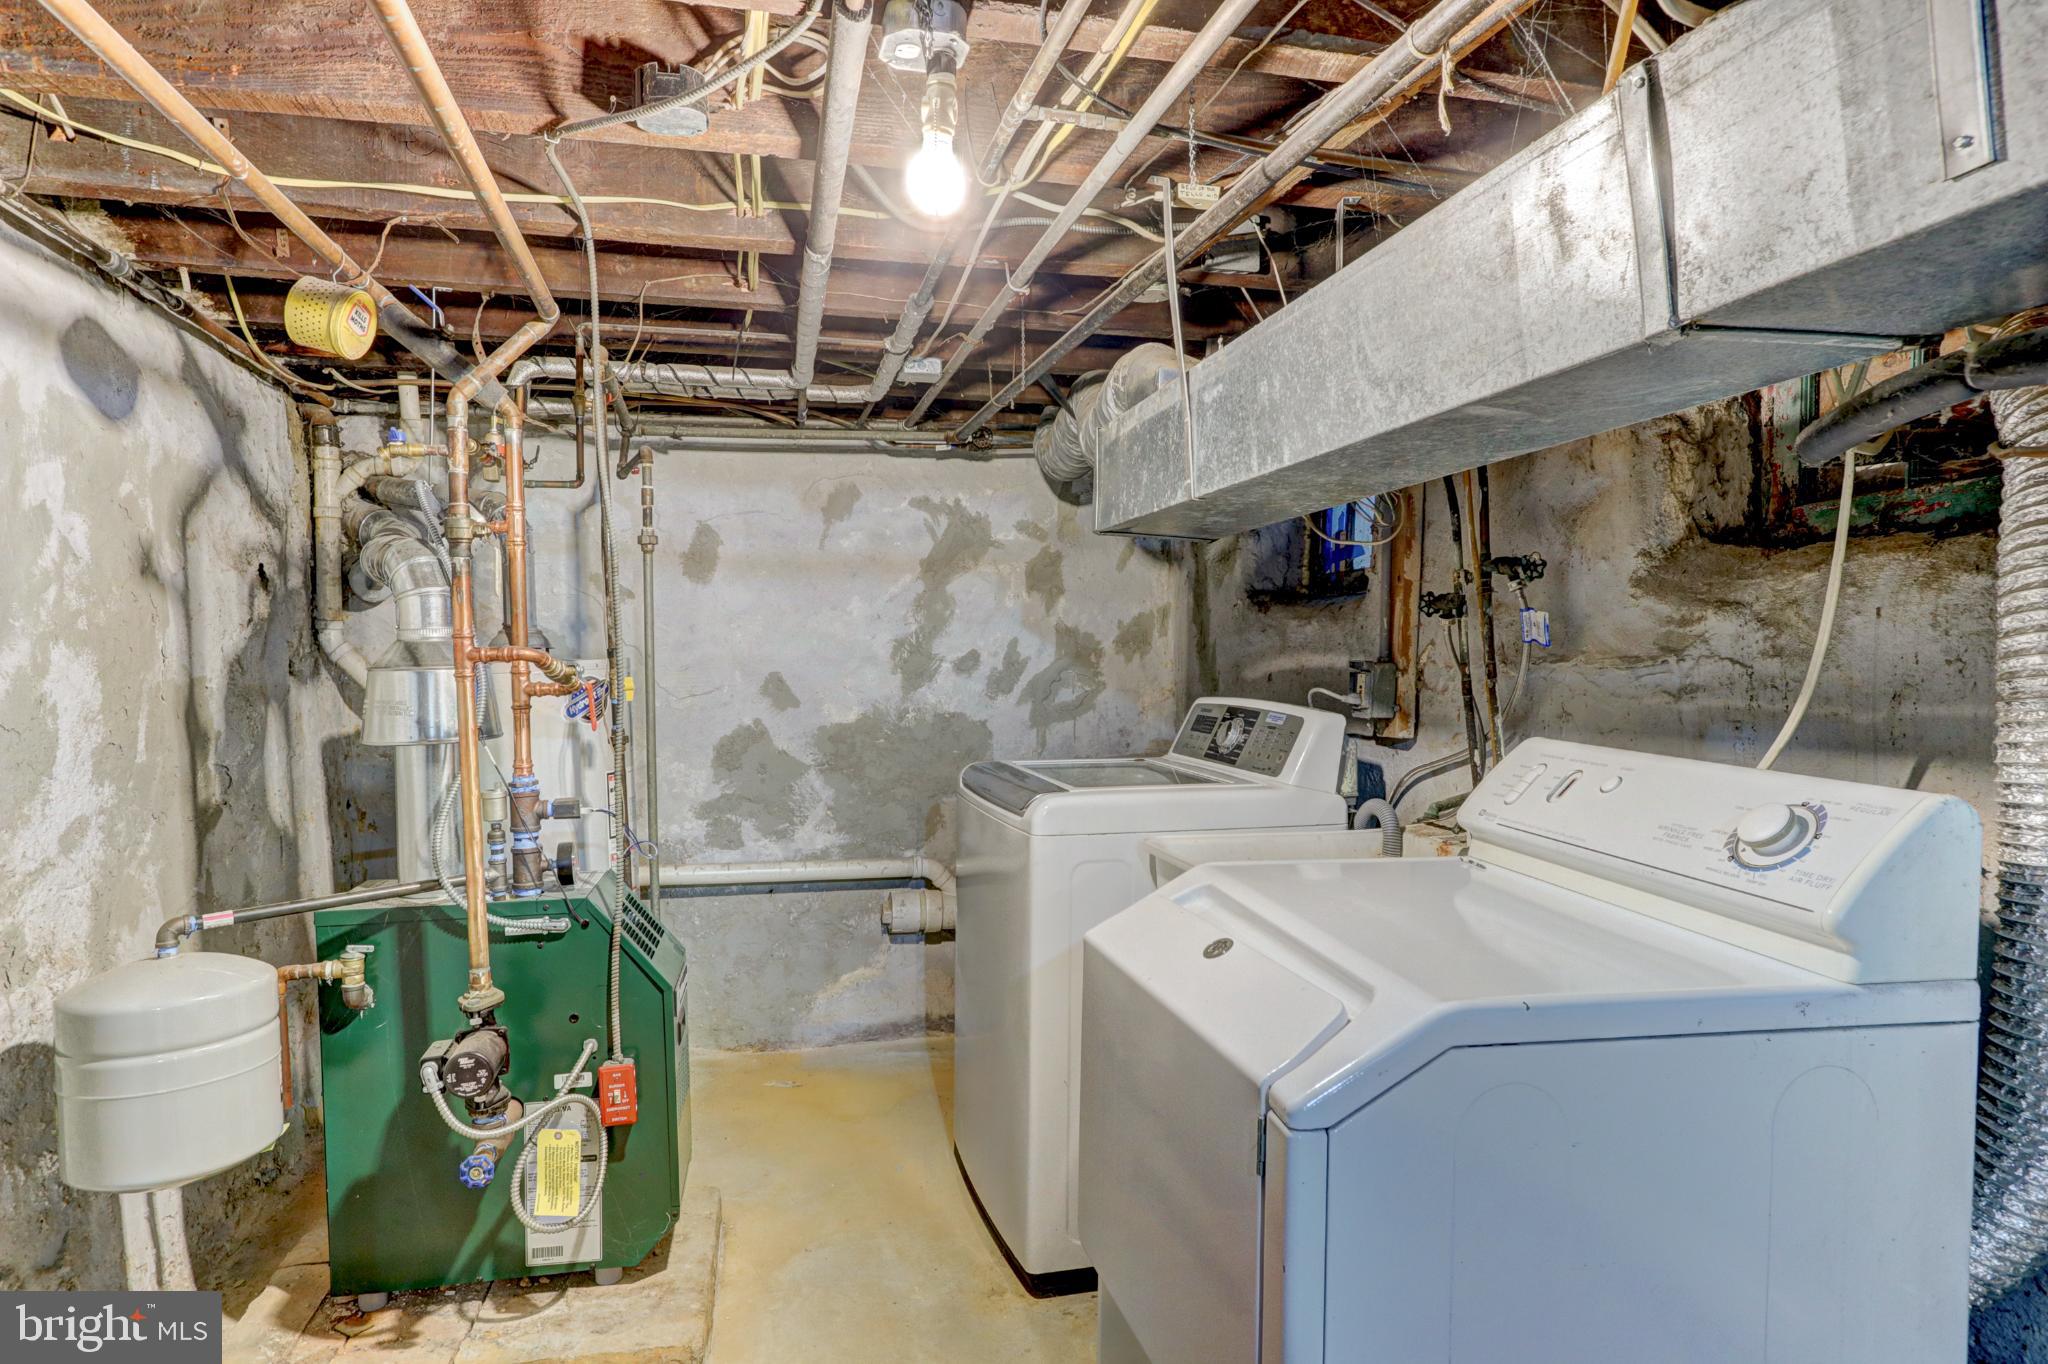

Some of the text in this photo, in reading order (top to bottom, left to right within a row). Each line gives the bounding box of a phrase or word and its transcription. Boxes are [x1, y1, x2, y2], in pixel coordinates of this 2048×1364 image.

[350, 316, 366, 332] MOTHS
[354, 309, 367, 324] KILLS
[1803, 879, 1833, 890] FLUFF
